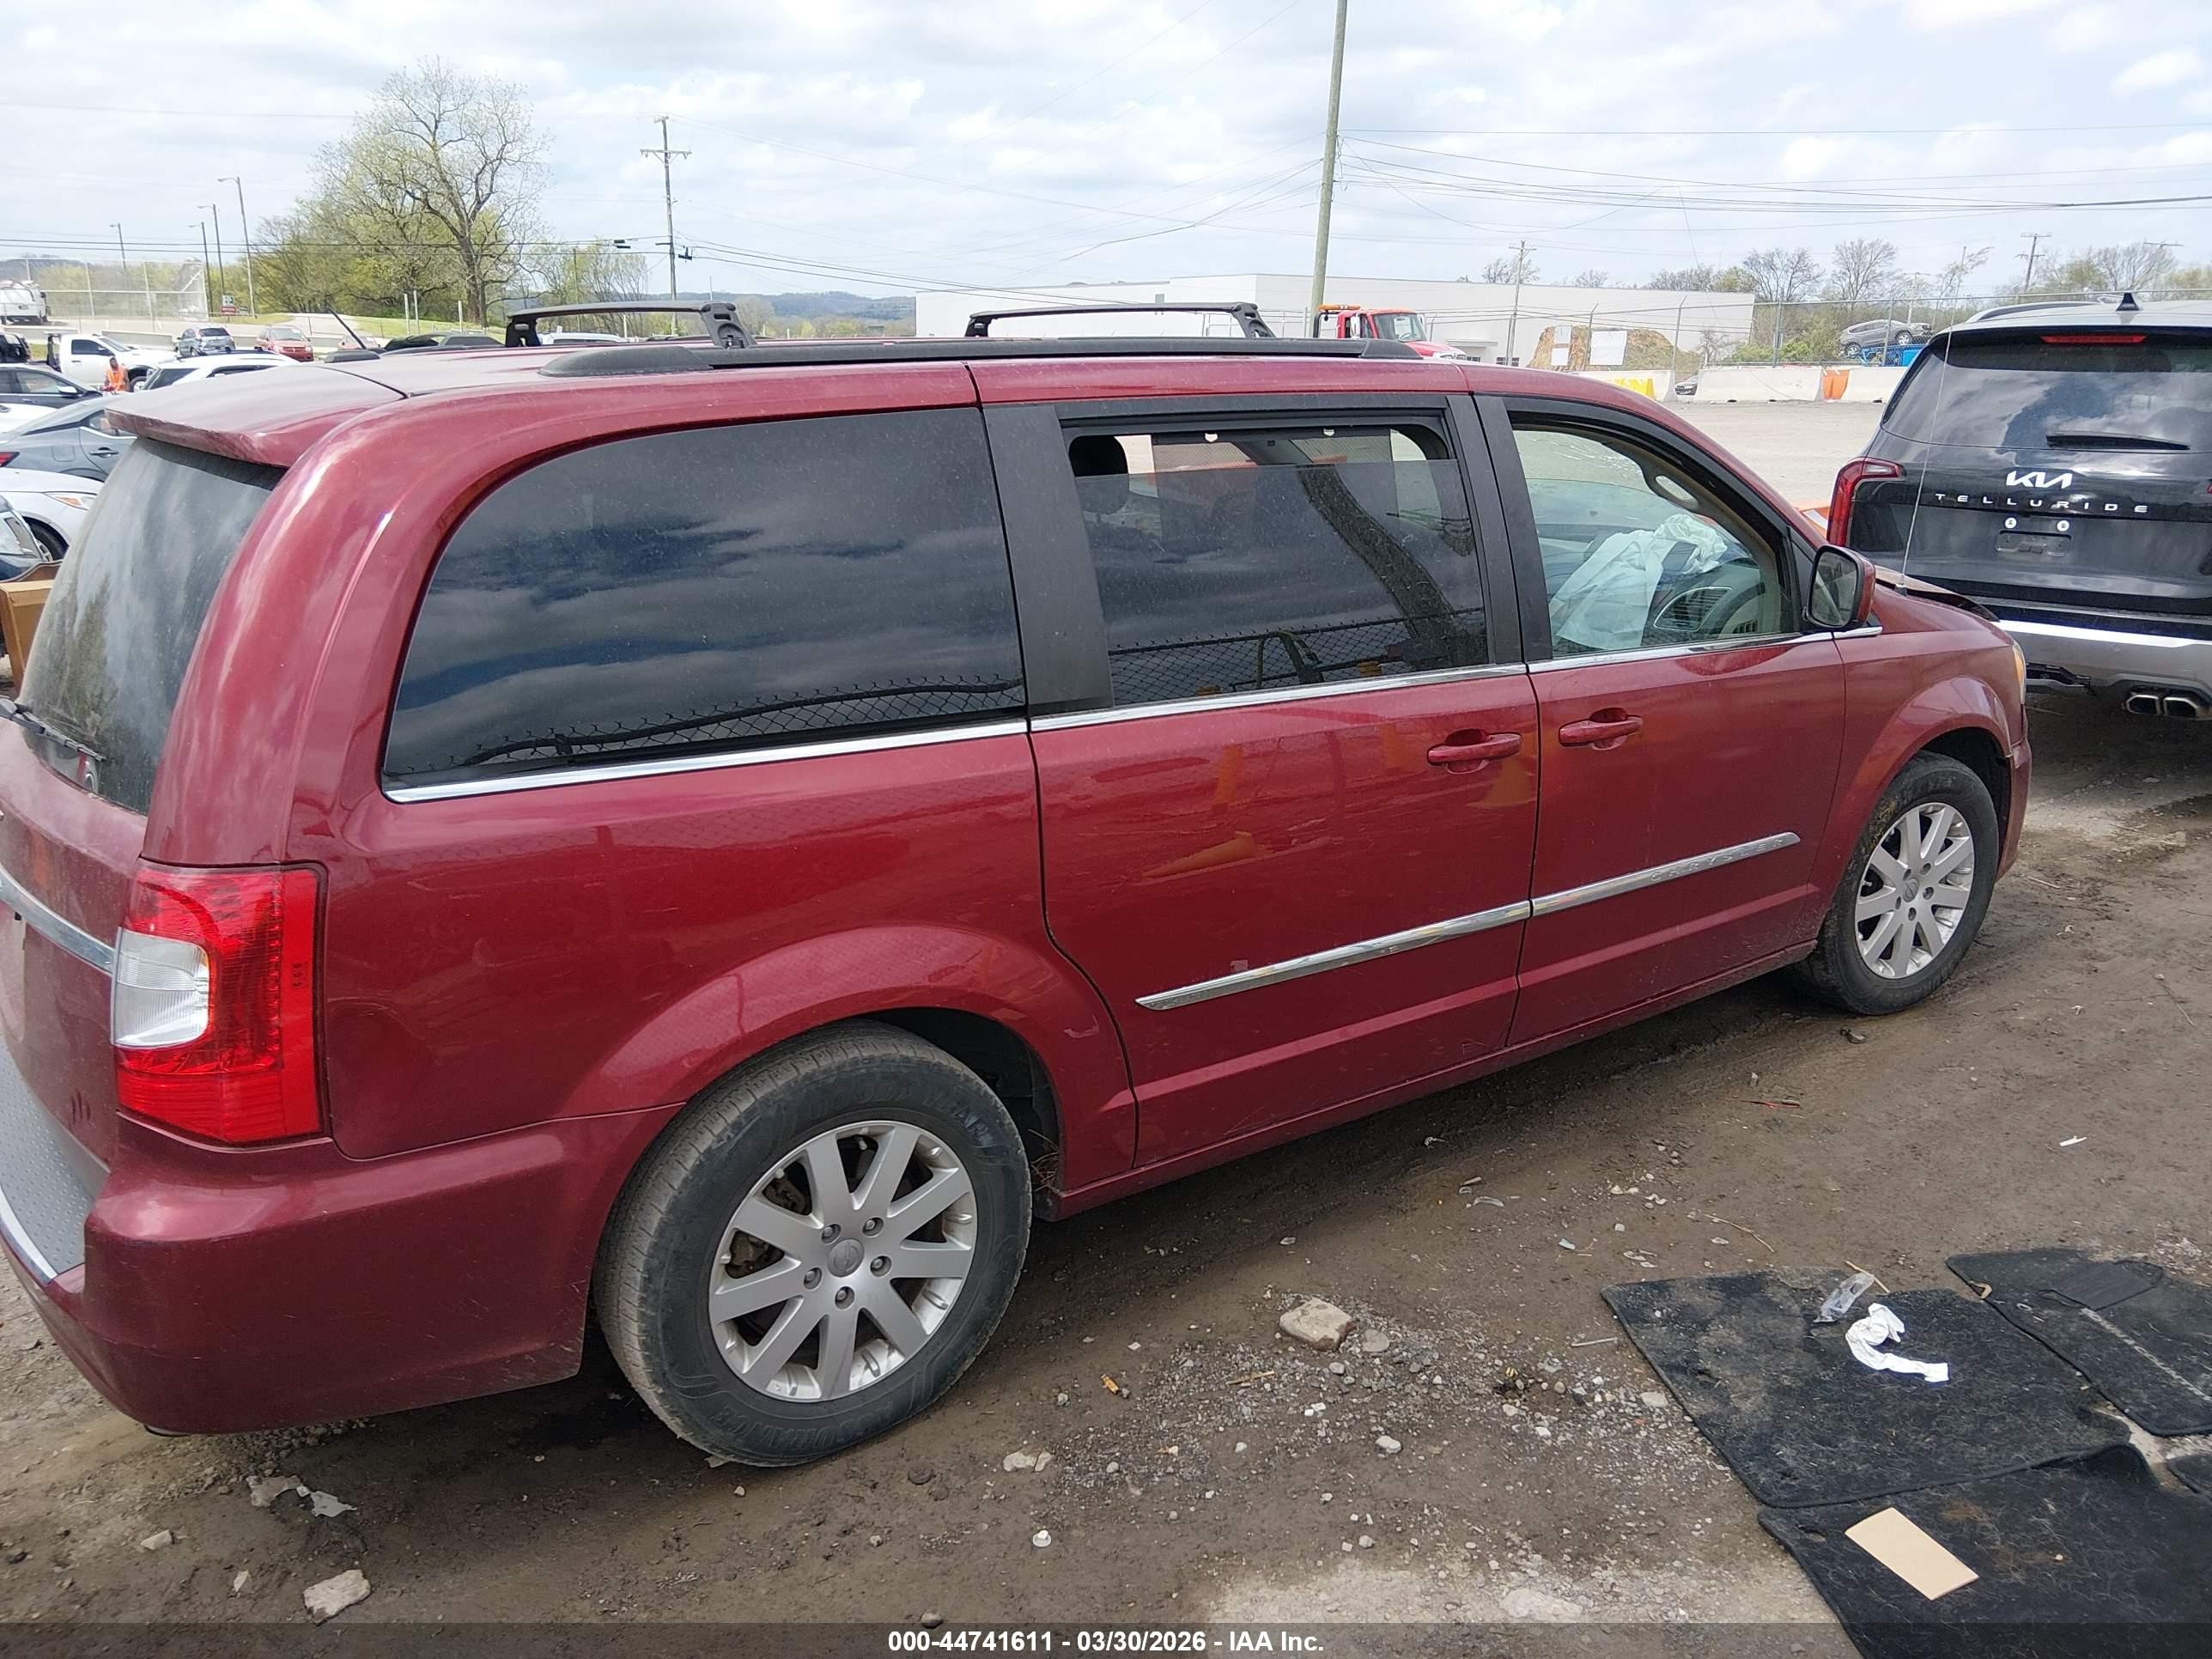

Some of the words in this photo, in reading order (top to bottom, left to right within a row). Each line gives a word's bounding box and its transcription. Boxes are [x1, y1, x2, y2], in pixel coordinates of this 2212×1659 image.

[2006, 471, 2074, 489] KIA
[1935, 493, 2148, 514] TELLURIDE
[1650, 838, 1784, 883] CHRYSLER
